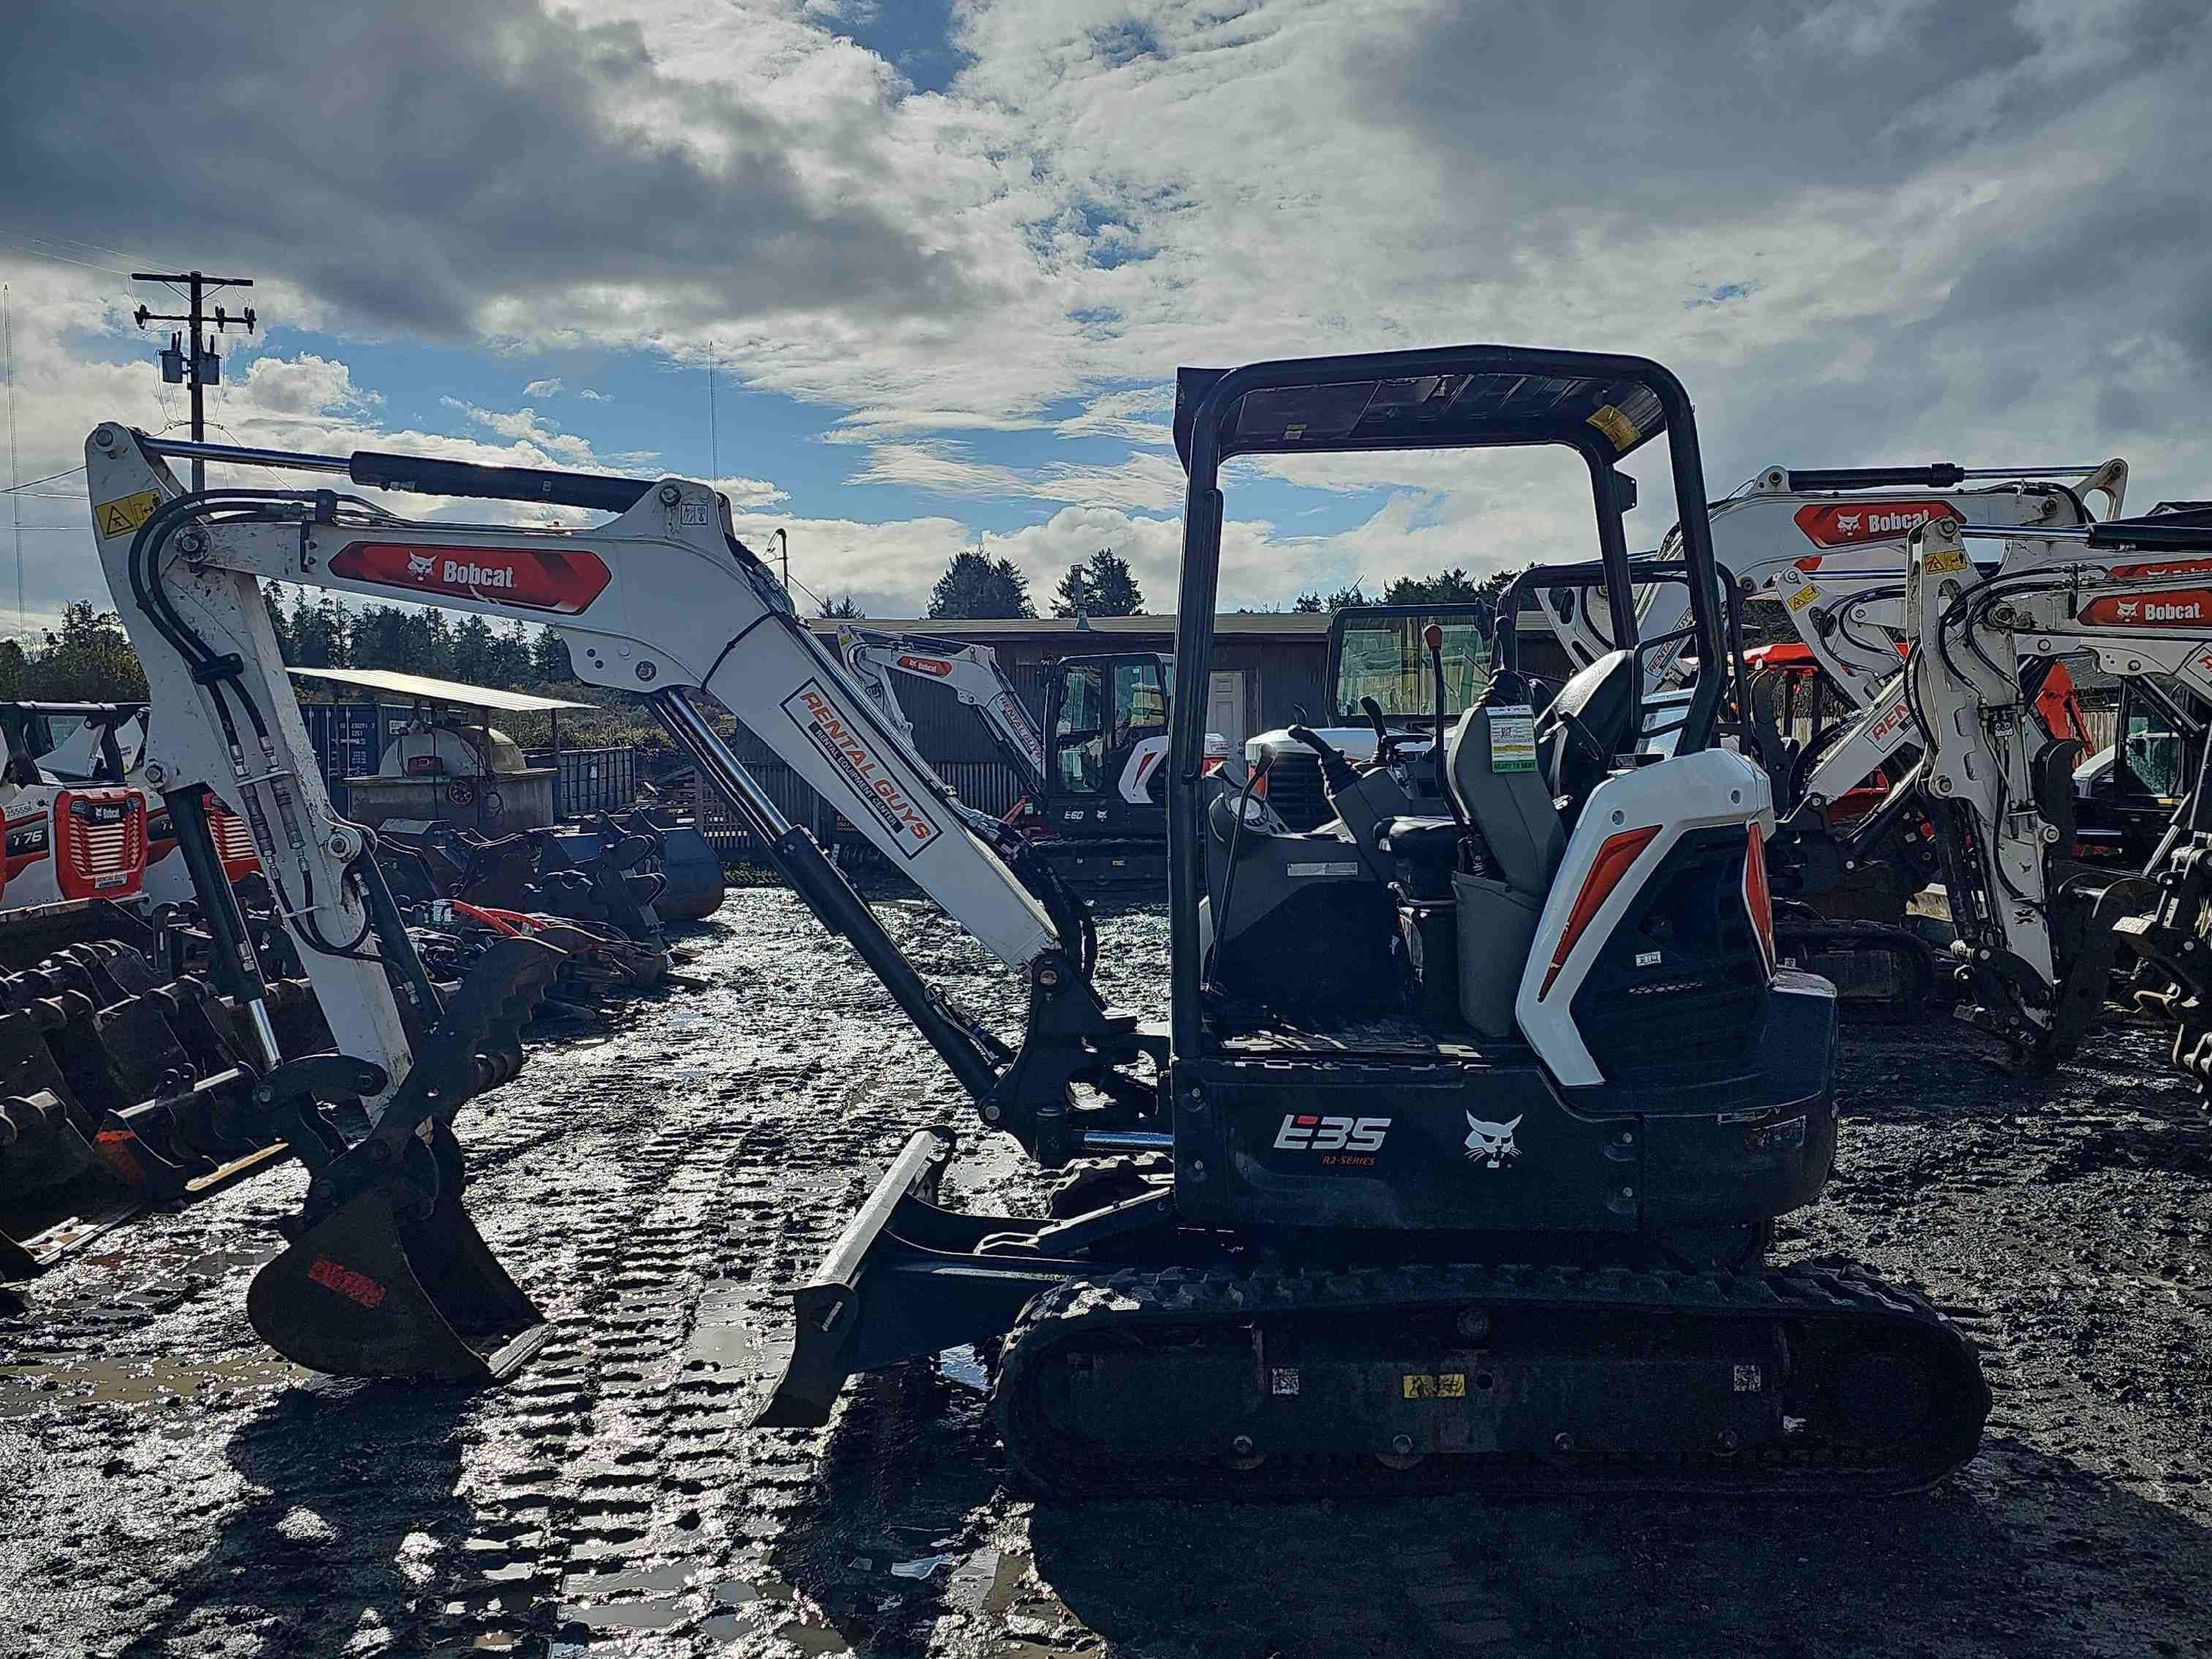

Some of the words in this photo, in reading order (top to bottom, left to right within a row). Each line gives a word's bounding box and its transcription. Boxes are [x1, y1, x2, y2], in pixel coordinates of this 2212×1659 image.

[1868, 509, 1930, 533] Bobcat
[443, 560, 514, 588] Bobcat
[2145, 602, 2201, 621] Bobcat
[1873, 704, 1909, 742] REN
[801, 692, 878, 780] RENTAL
[873, 779, 932, 840] GUYS
[816, 731, 840, 758] RENTAL
[837, 756, 873, 799] EQUIPMENT
[873, 797, 897, 827] CENTER
[1064, 810, 1085, 820] E60
[12, 830, 44, 846] T76
[1273, 1114, 1393, 1151] E35
[1322, 1155, 1376, 1166] R2-SERIES
